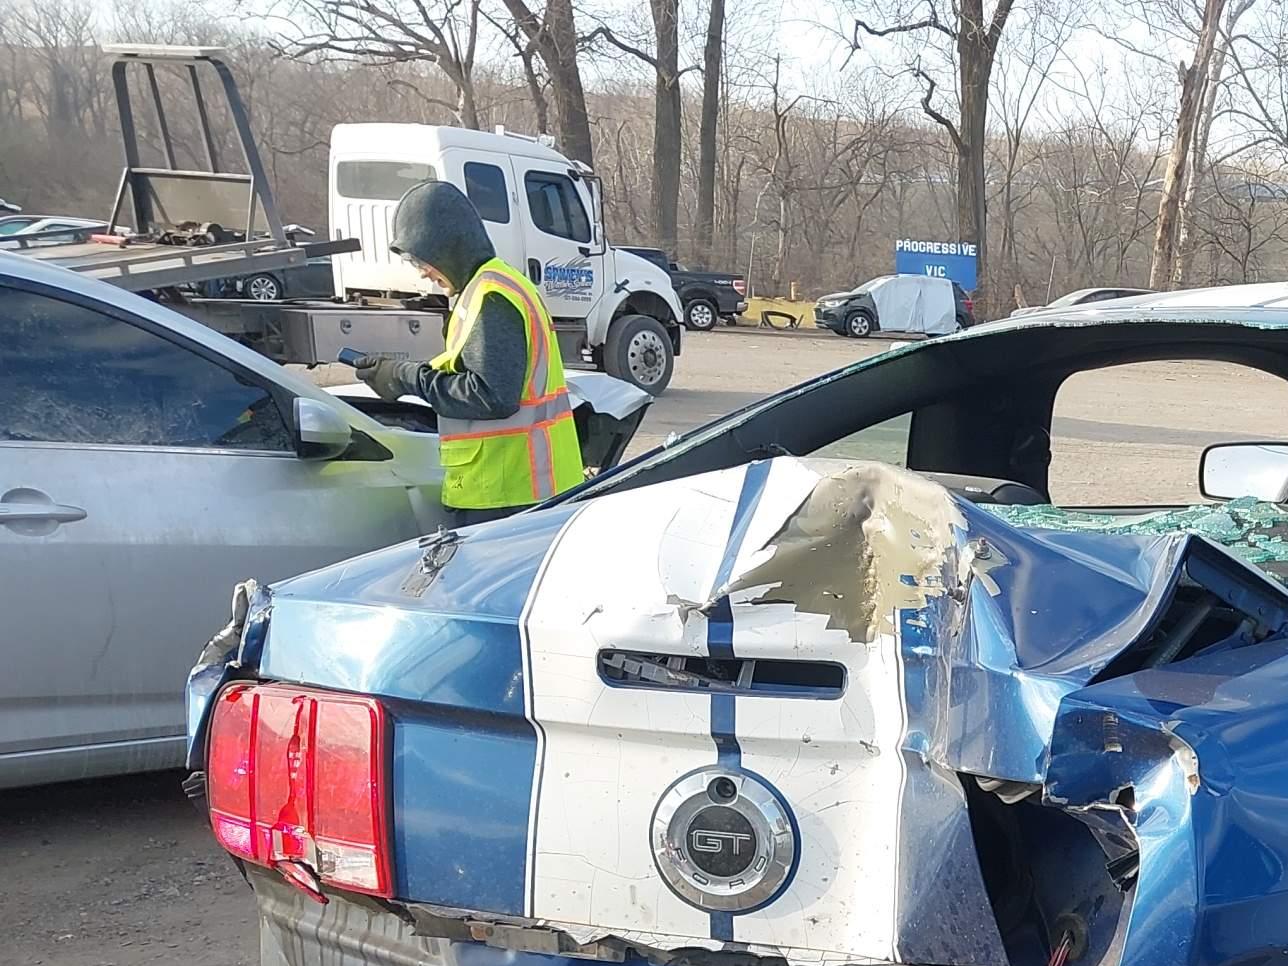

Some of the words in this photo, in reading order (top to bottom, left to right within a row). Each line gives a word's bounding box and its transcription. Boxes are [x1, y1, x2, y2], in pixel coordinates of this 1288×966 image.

[896, 239, 977, 257] PROGRESSIVE
[925, 265, 946, 277] VIC
[690, 830, 752, 856] GT
[672, 847, 767, 890] FORD
